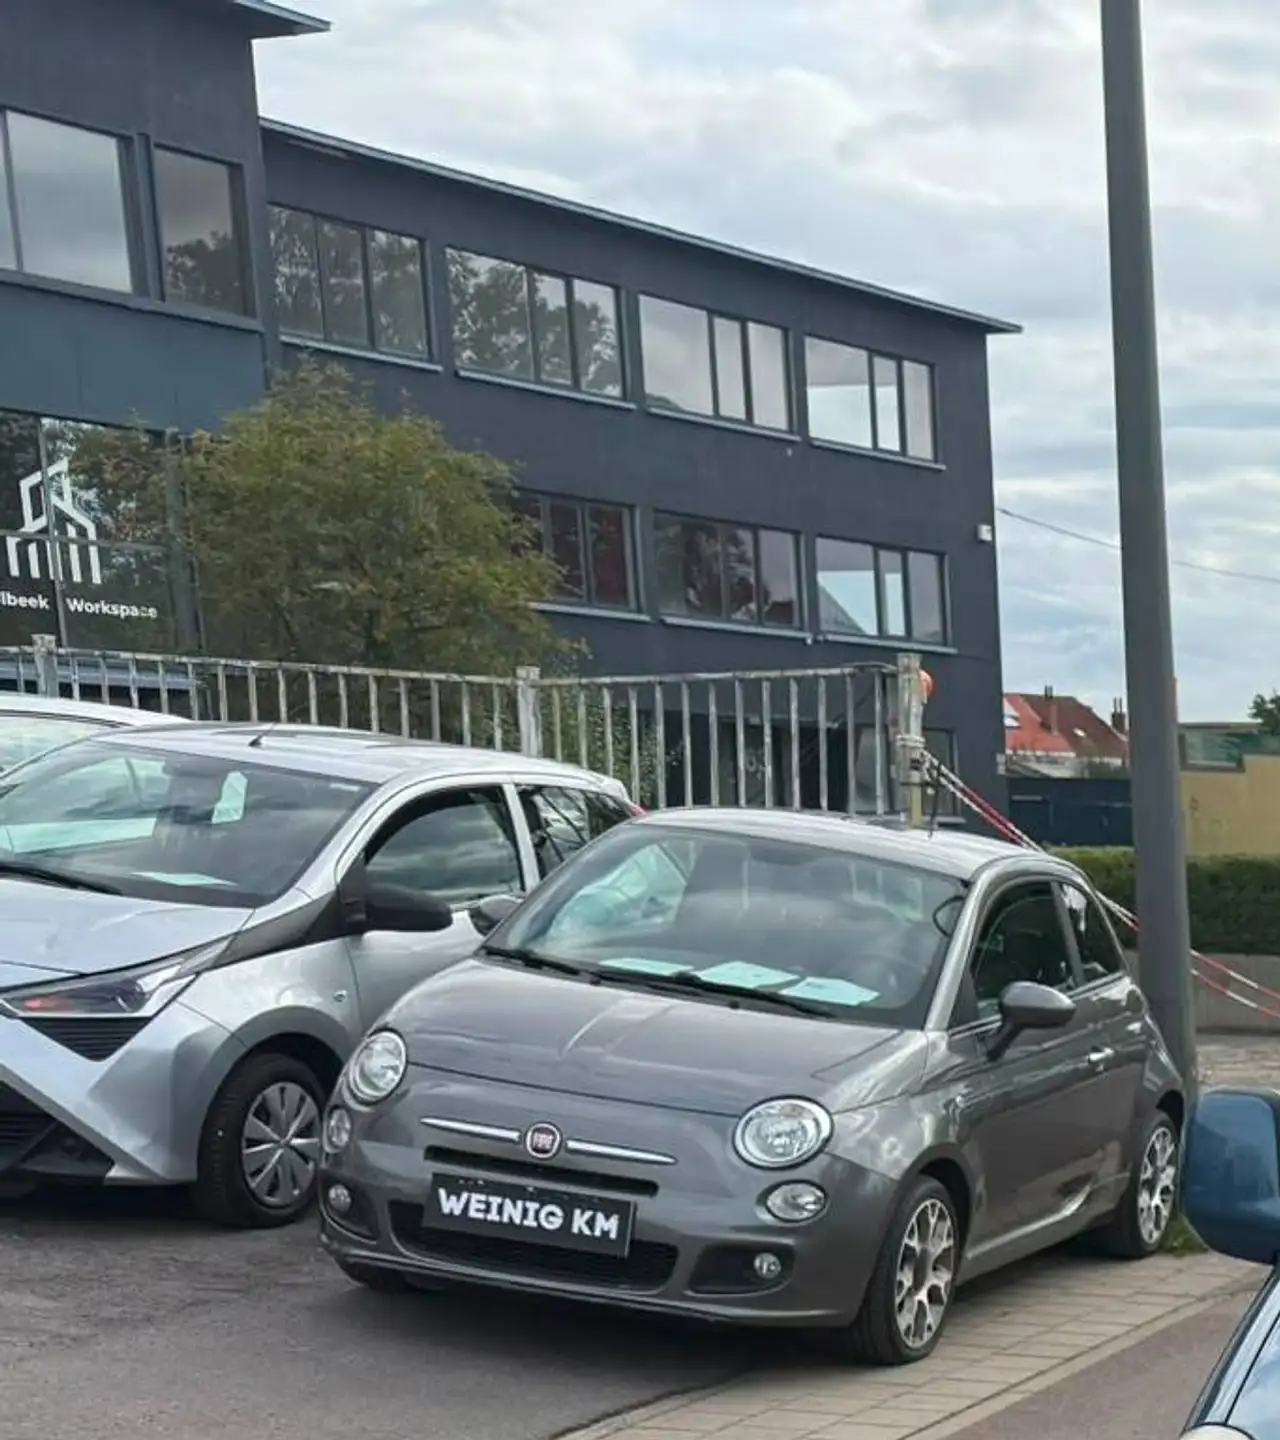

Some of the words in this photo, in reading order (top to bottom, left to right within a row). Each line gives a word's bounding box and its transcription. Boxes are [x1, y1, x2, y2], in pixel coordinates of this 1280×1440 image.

[0, 591, 50, 609] lbeek
[65, 597, 158, 619] Workspace
[438, 1187, 565, 1230] WEINIG
[571, 1208, 620, 1240] KM
